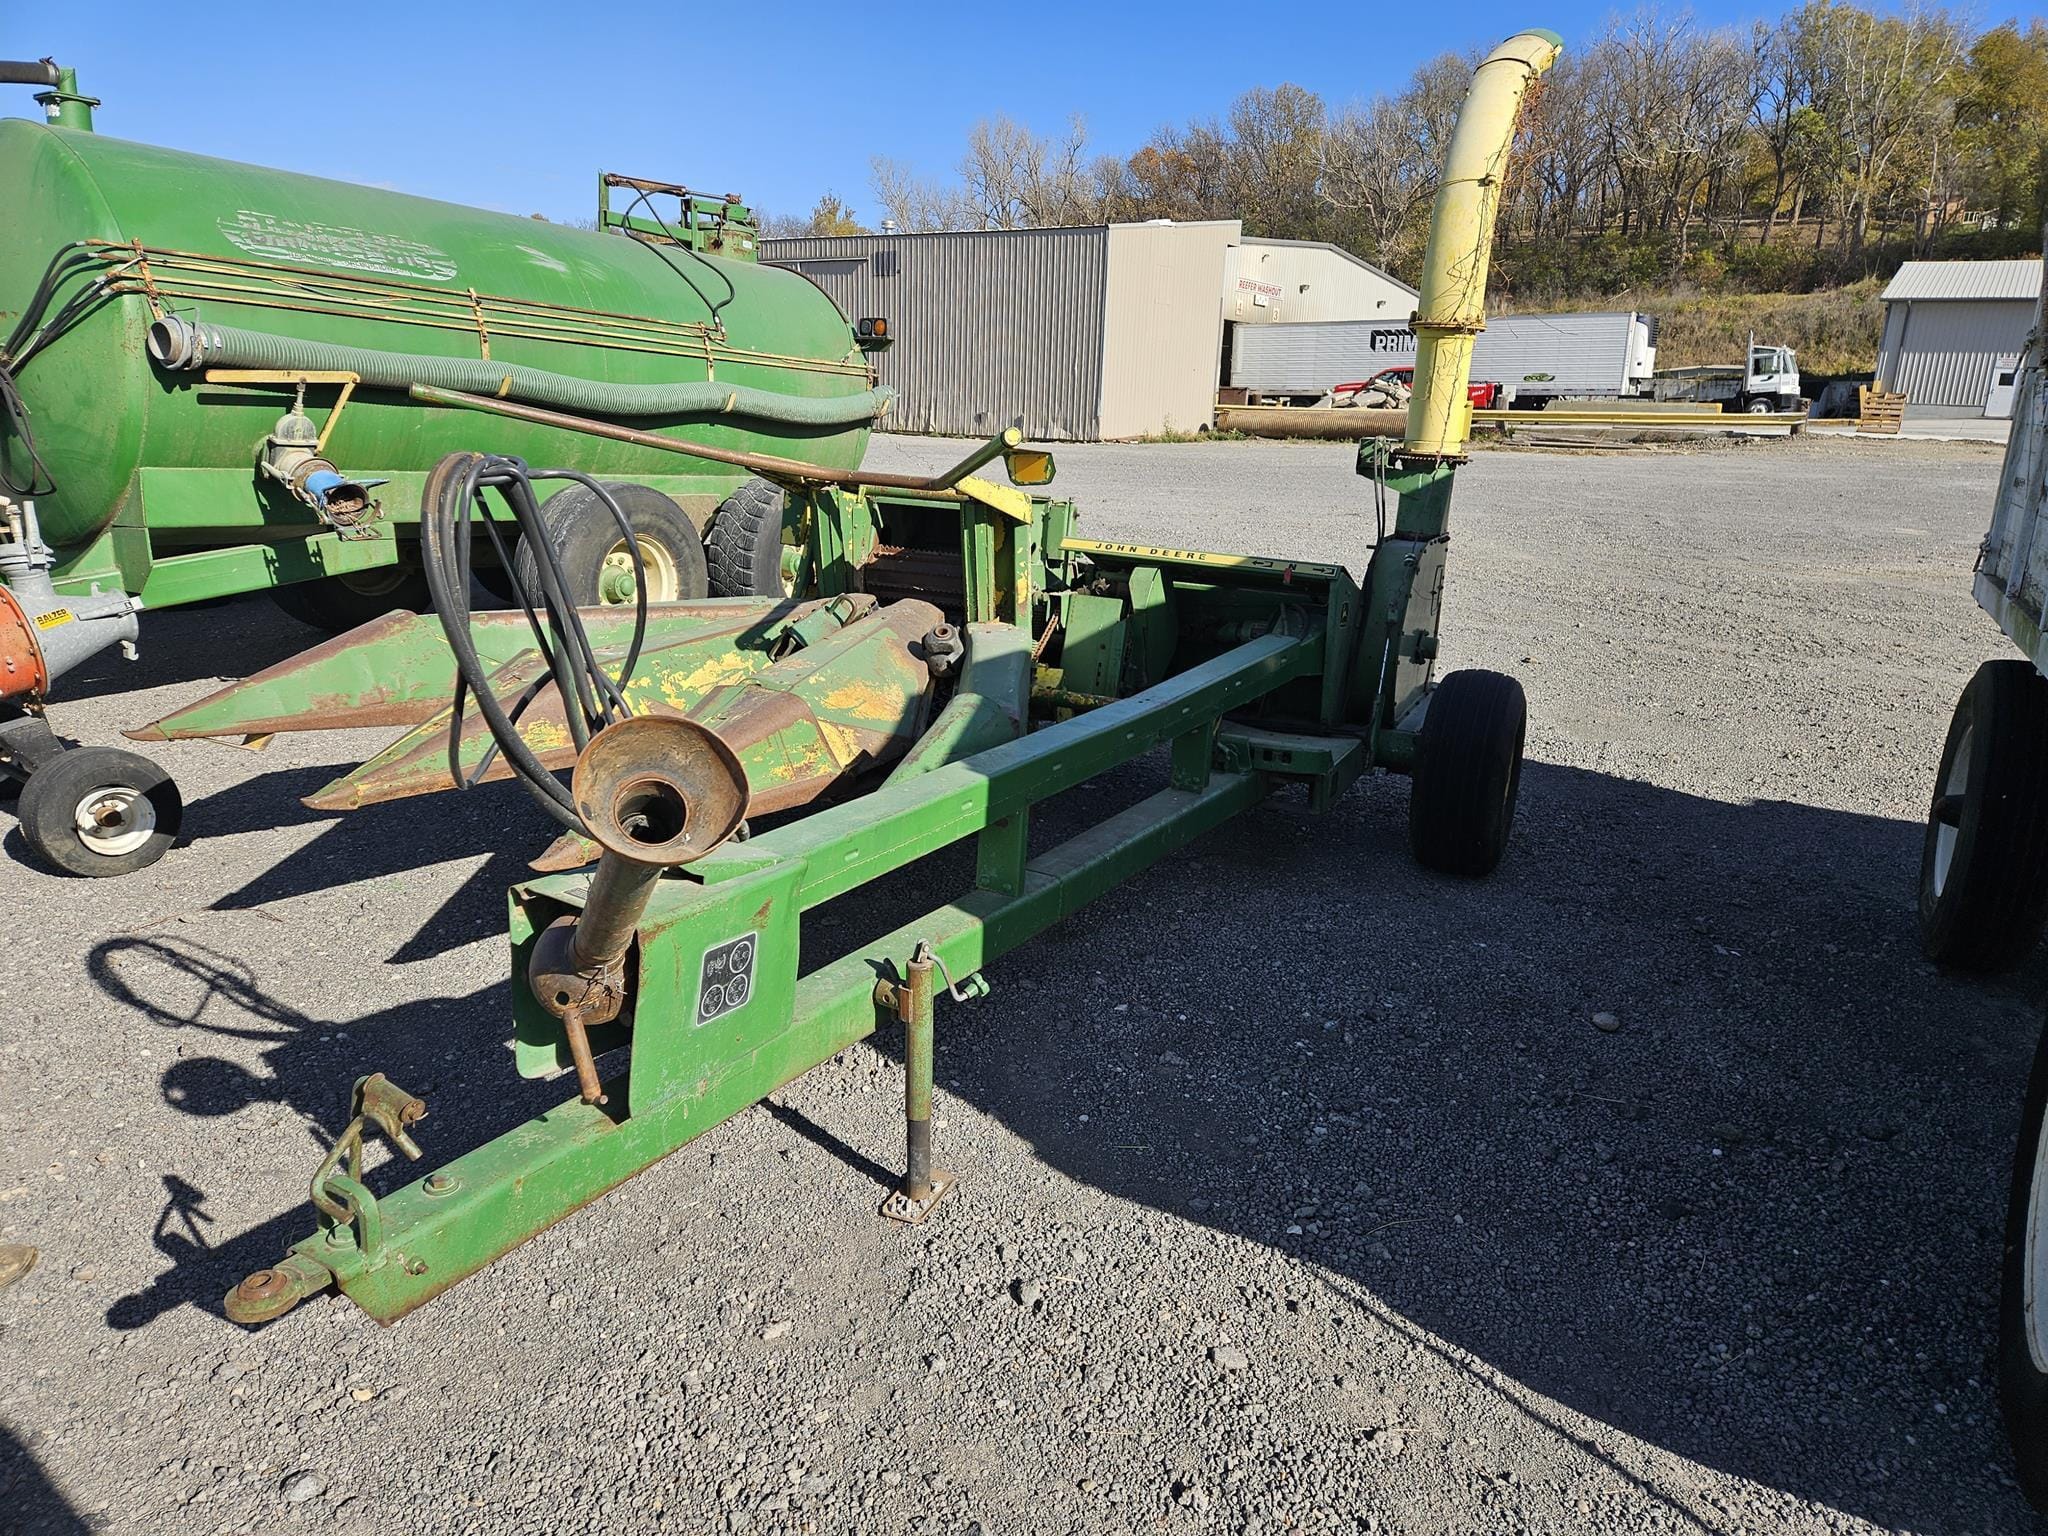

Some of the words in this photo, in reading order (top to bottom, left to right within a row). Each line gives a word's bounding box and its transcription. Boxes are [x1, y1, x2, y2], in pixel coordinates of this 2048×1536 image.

[1239, 280, 1257, 291] REEFER
[1257, 284, 1282, 297] WASHOUT
[1095, 543, 1137, 553] JOHN
[1150, 548, 1207, 560] DEERE
